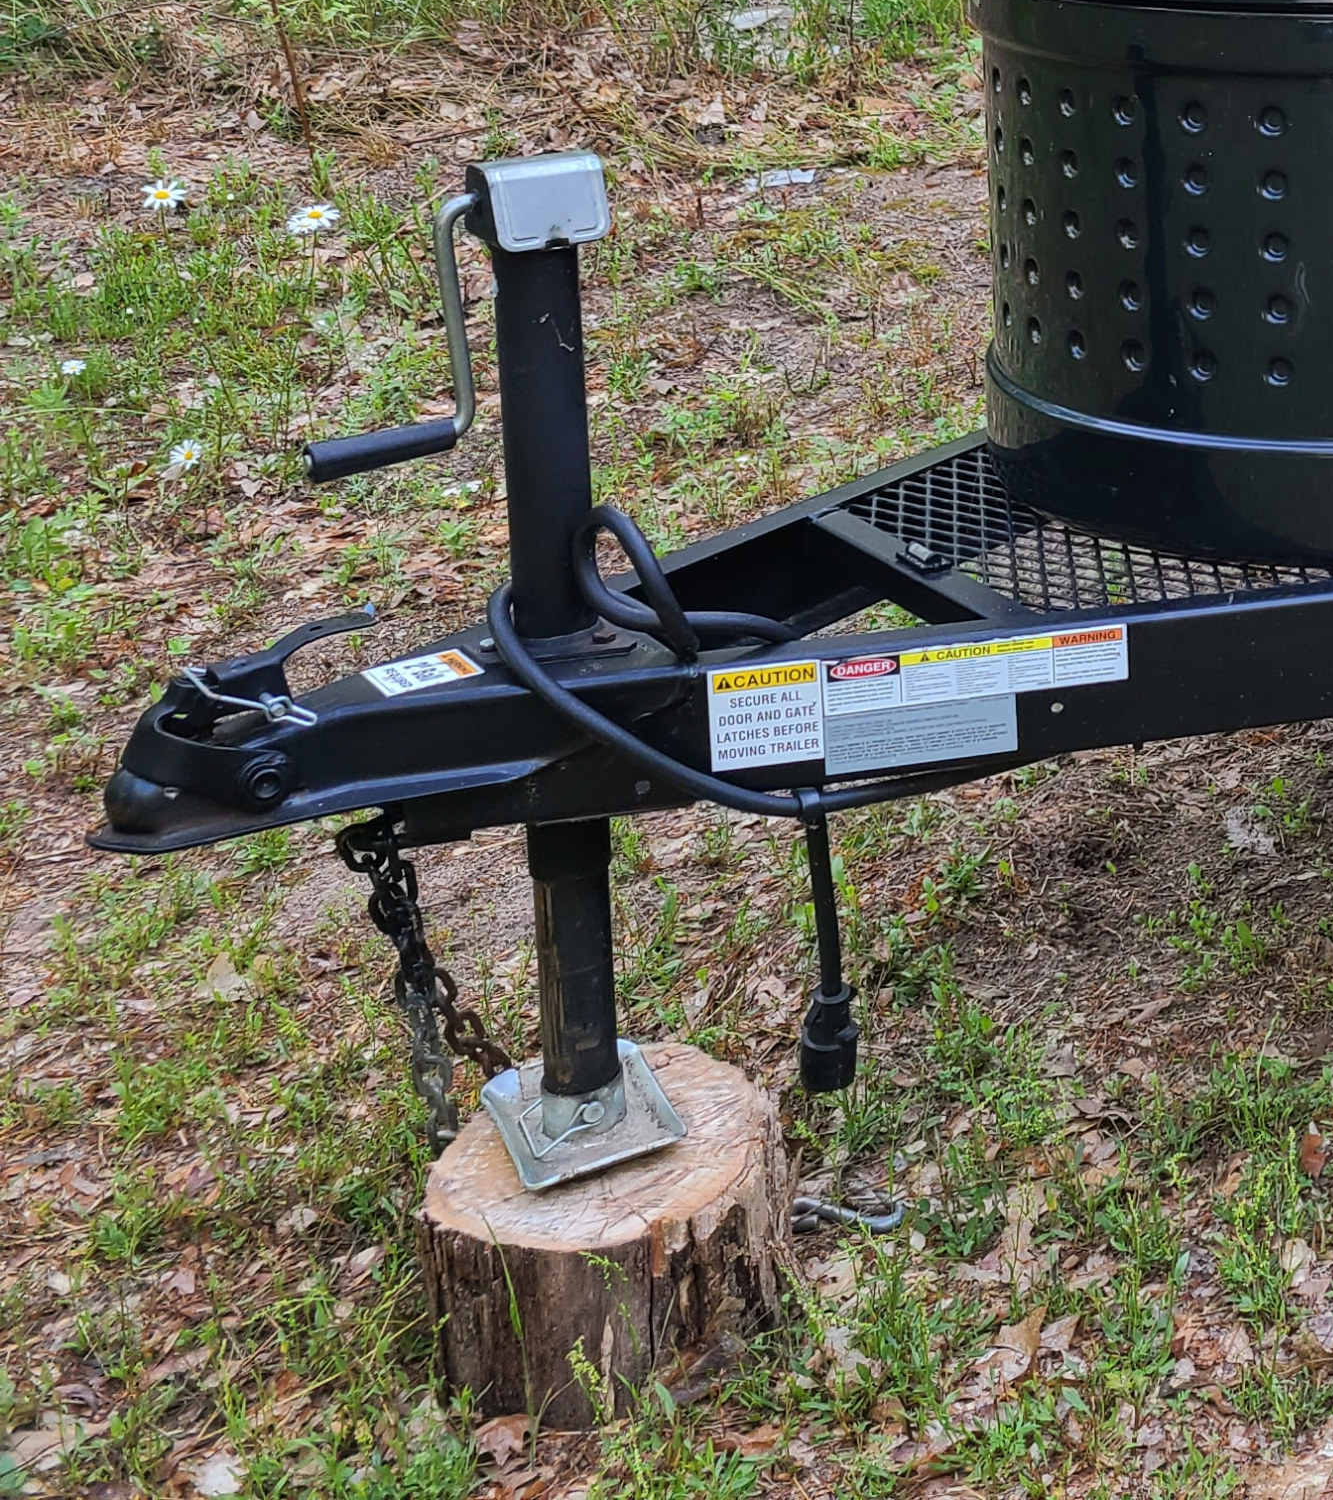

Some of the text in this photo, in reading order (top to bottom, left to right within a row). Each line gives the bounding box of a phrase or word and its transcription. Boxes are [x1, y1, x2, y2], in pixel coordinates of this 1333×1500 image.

[1059, 630, 1116, 645] WARNING
[936, 645, 991, 660] CAUTION
[733, 667, 815, 689] CAUTION
[836, 661, 891, 676] DANGER
[729, 690, 803, 709] SECURE ALL
[718, 705, 816, 728] DOOR AND GATE
[716, 721, 820, 744] LATCHES BEFORE
[718, 738, 820, 761] MOVING TRAILER
